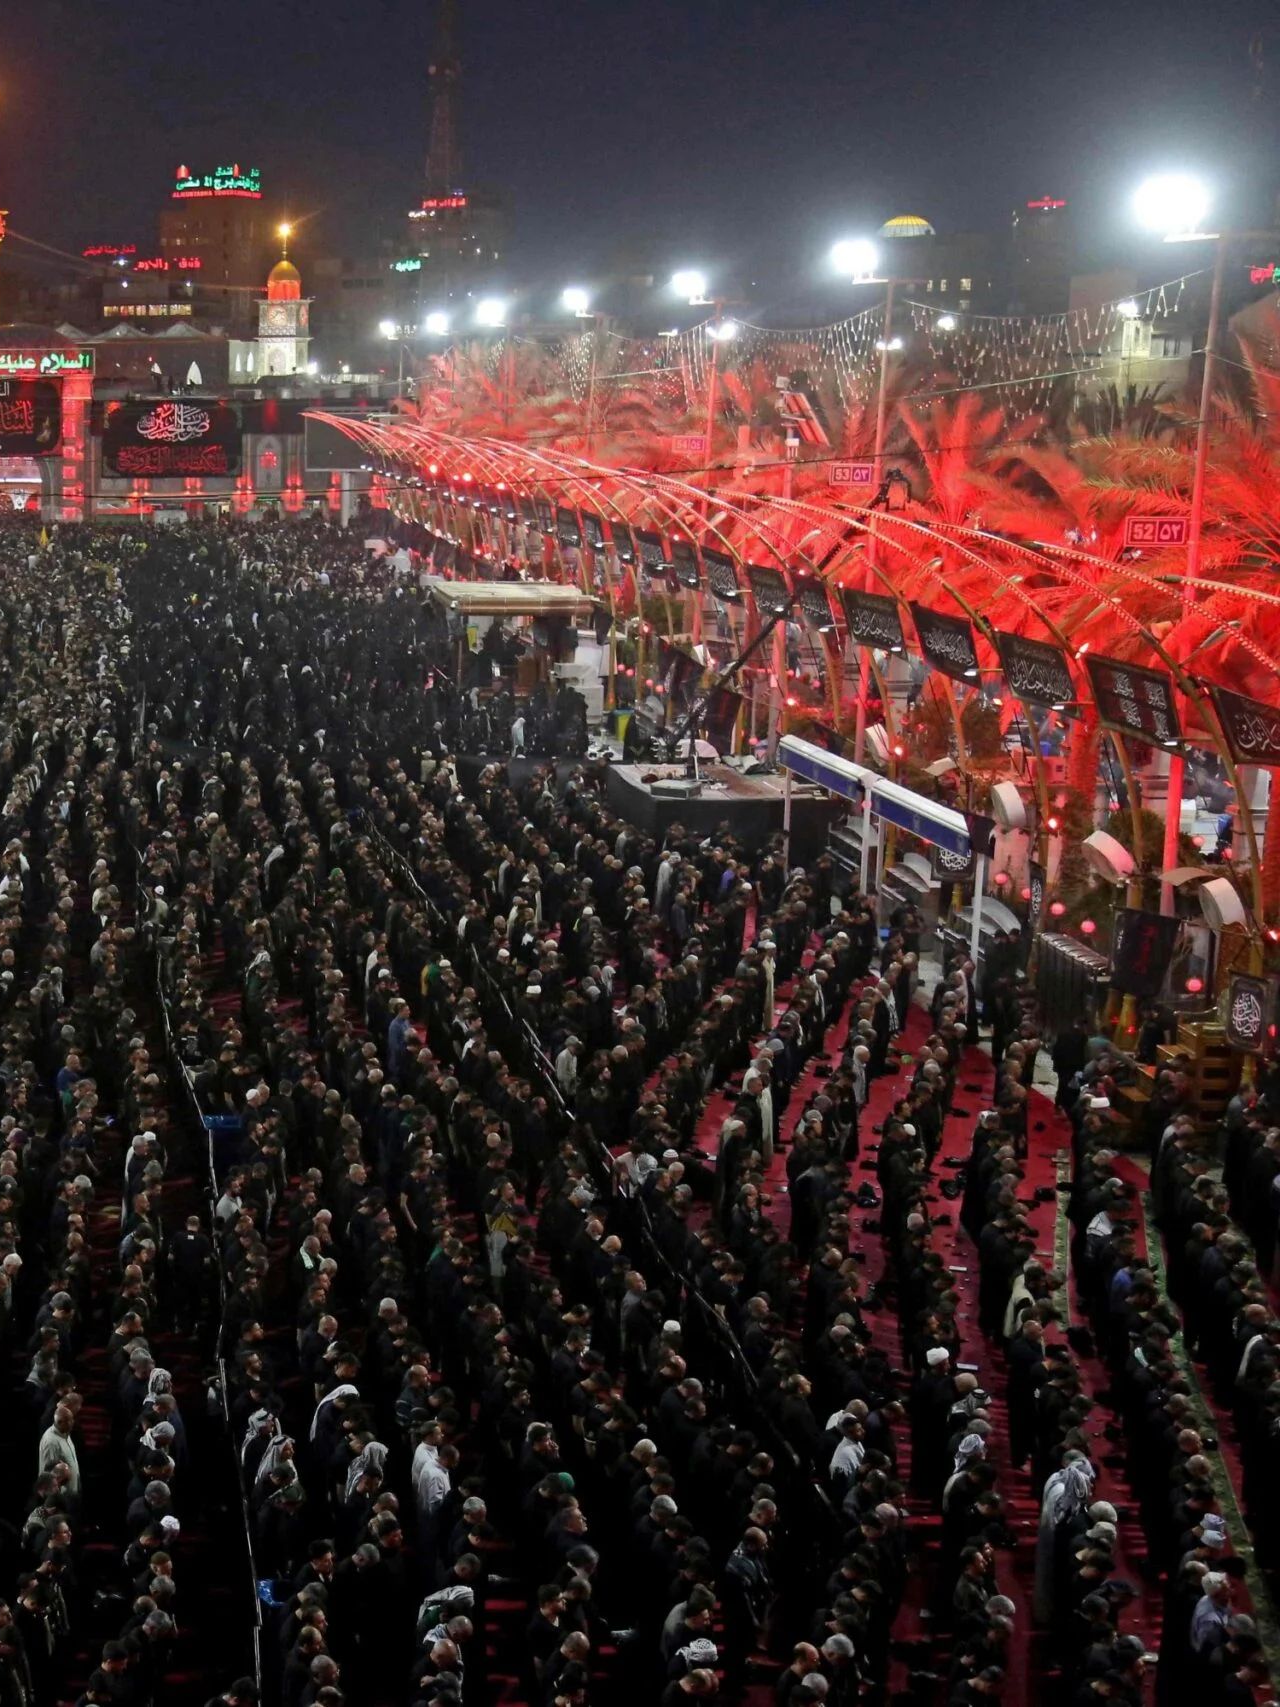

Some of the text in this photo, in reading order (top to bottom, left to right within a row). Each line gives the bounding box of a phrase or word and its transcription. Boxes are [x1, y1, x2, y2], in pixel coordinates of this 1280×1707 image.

[40, 353, 89, 374] السلام
[835, 468, 850, 480] 53
[1133, 524, 1155, 540] 52
